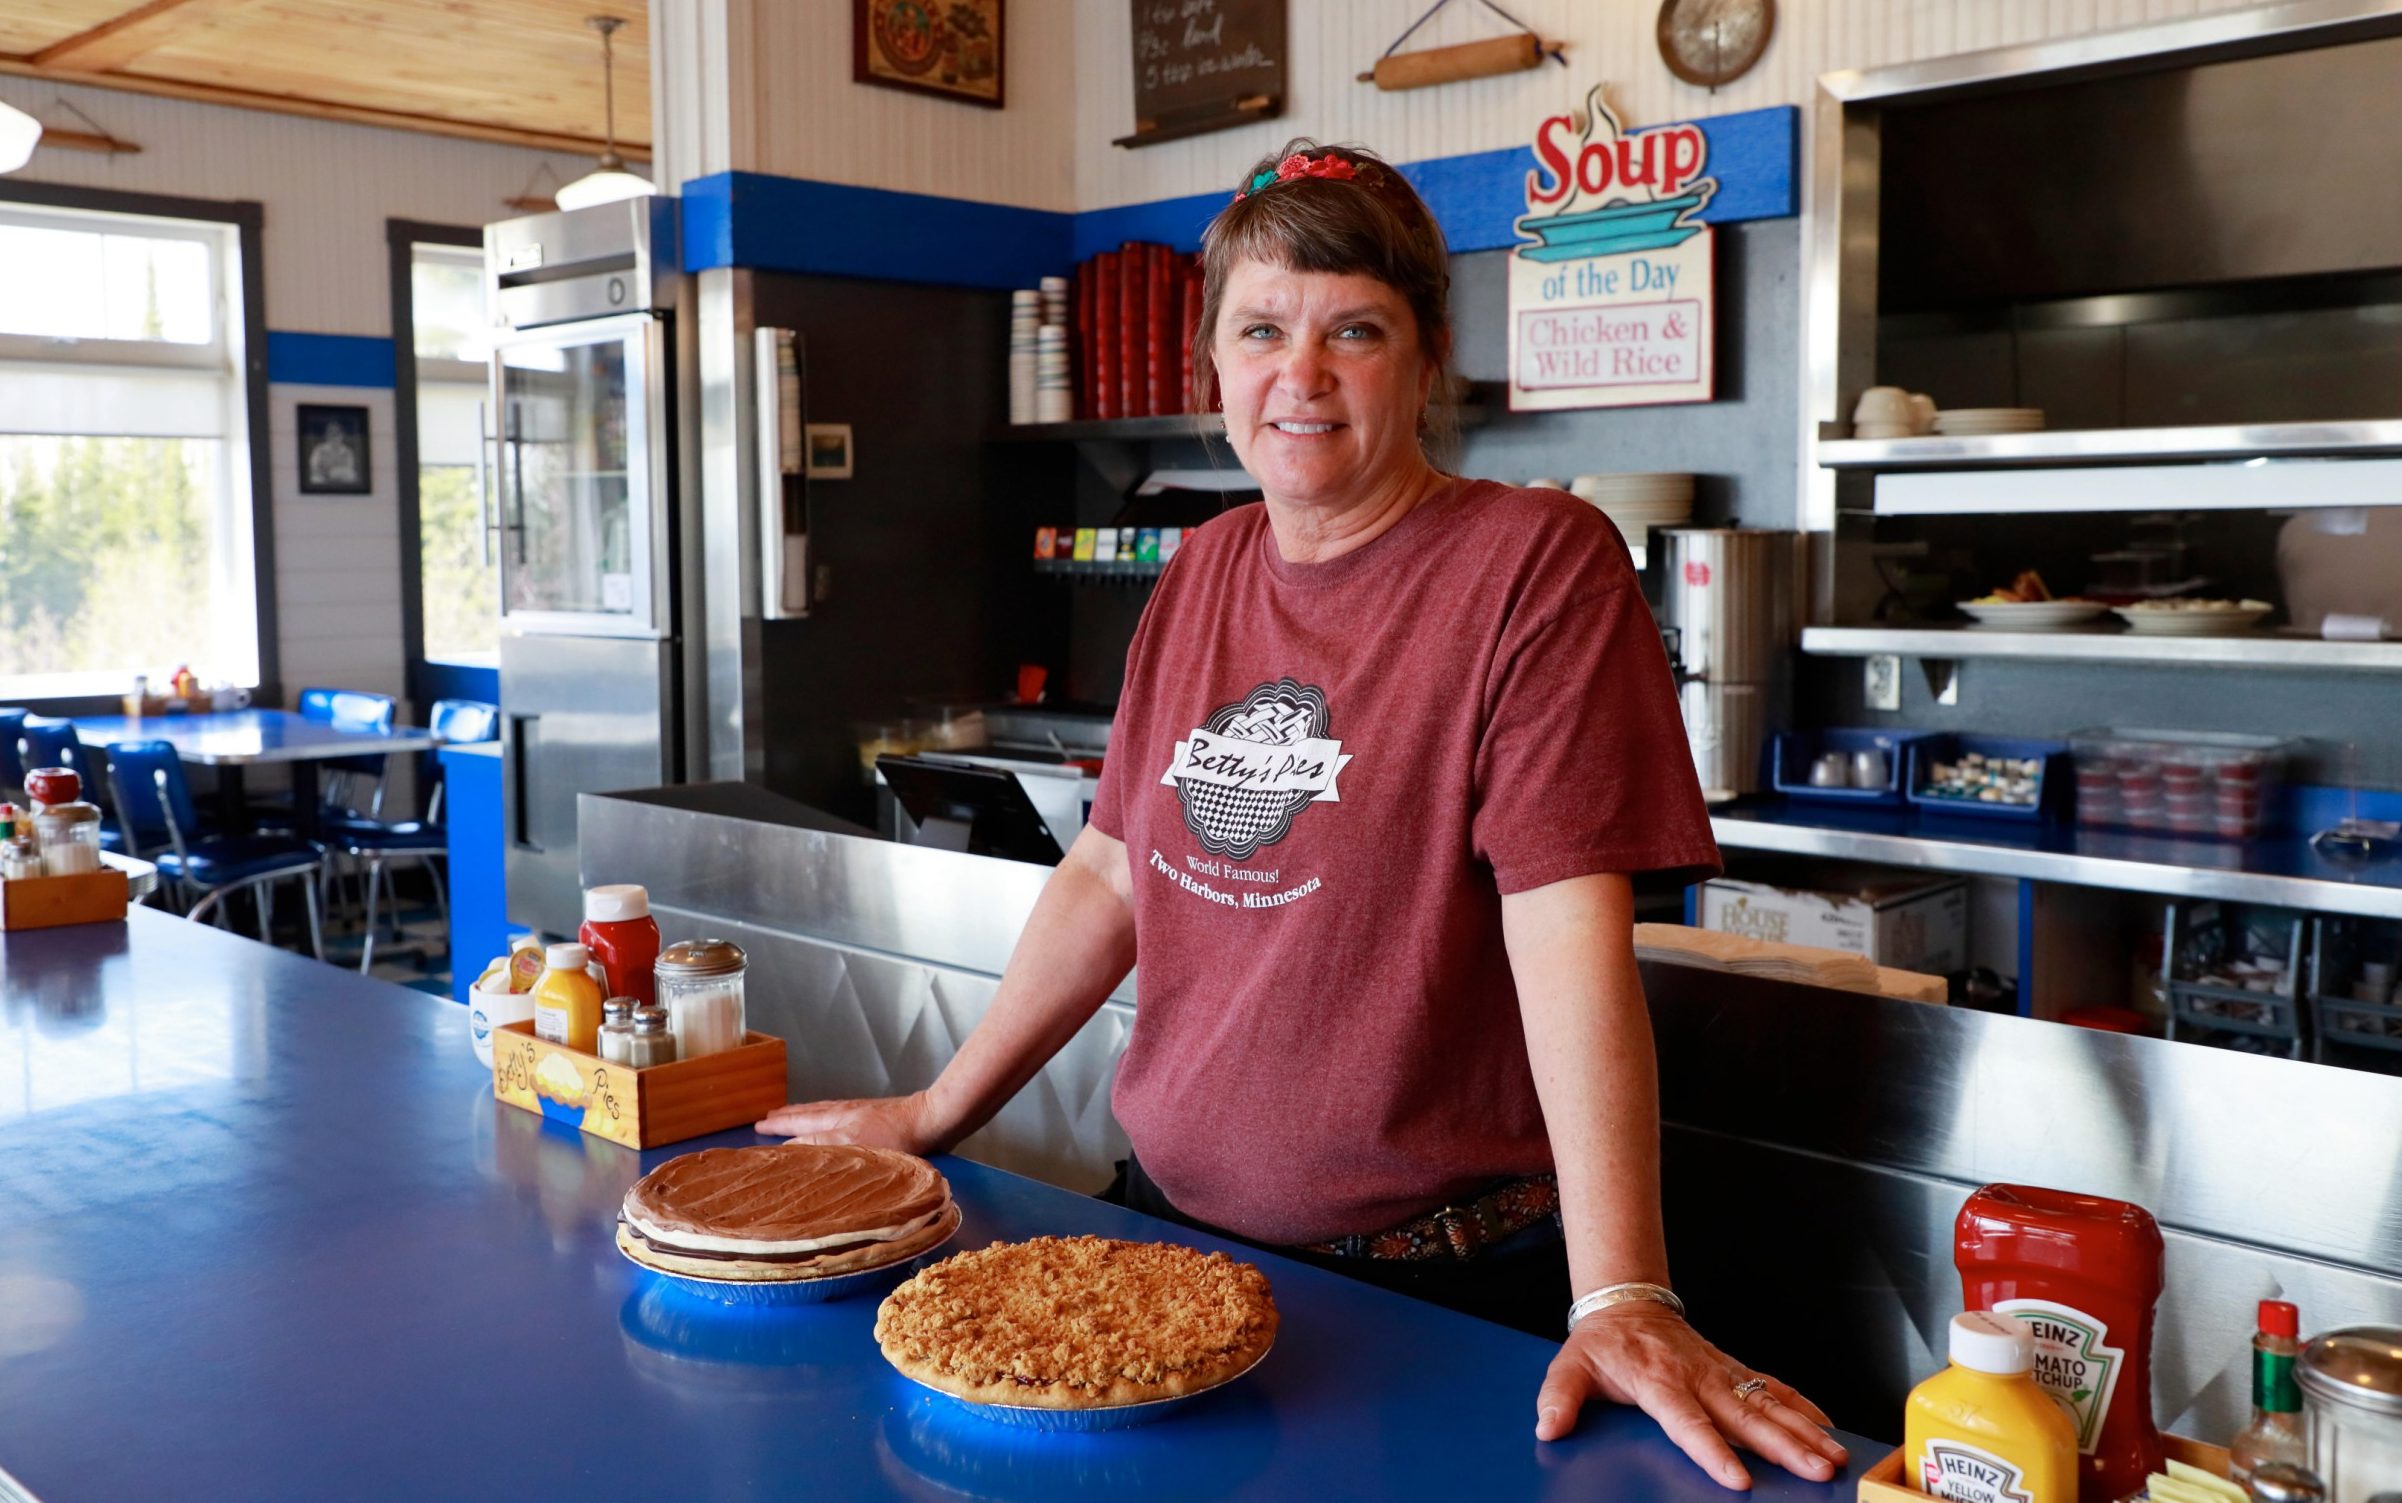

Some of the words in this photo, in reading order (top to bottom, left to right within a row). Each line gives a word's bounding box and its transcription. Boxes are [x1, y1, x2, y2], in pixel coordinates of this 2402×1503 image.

[1529, 114, 1700, 205] Soup
[1542, 264, 1567, 301] of
[1577, 261, 1619, 298] the
[1630, 258, 1681, 302] Day
[1529, 315, 1649, 347] Chicken
[1662, 311, 1688, 340] &
[1535, 350, 1600, 379] Wild
[1611, 348, 1681, 377] Rice
[1186, 737, 1272, 790] Betty's
[1149, 849, 1178, 881] Two
[1179, 872, 1239, 909] Harbors,
[1243, 876, 1322, 909] Minnesota
[1186, 855, 1220, 877] World
[1223, 864, 1280, 884] Famous!
[1721, 903, 1789, 930] HOUSE
[593, 1067, 620, 1120] Pies
[2026, 1320, 2081, 1348] EINZ
[2033, 1368, 2083, 1389] TCHUP
[2034, 1352, 2087, 1378] MATO
[1944, 1457, 1999, 1487] HEINZ
[1946, 1479, 1996, 1503] YELLOW
